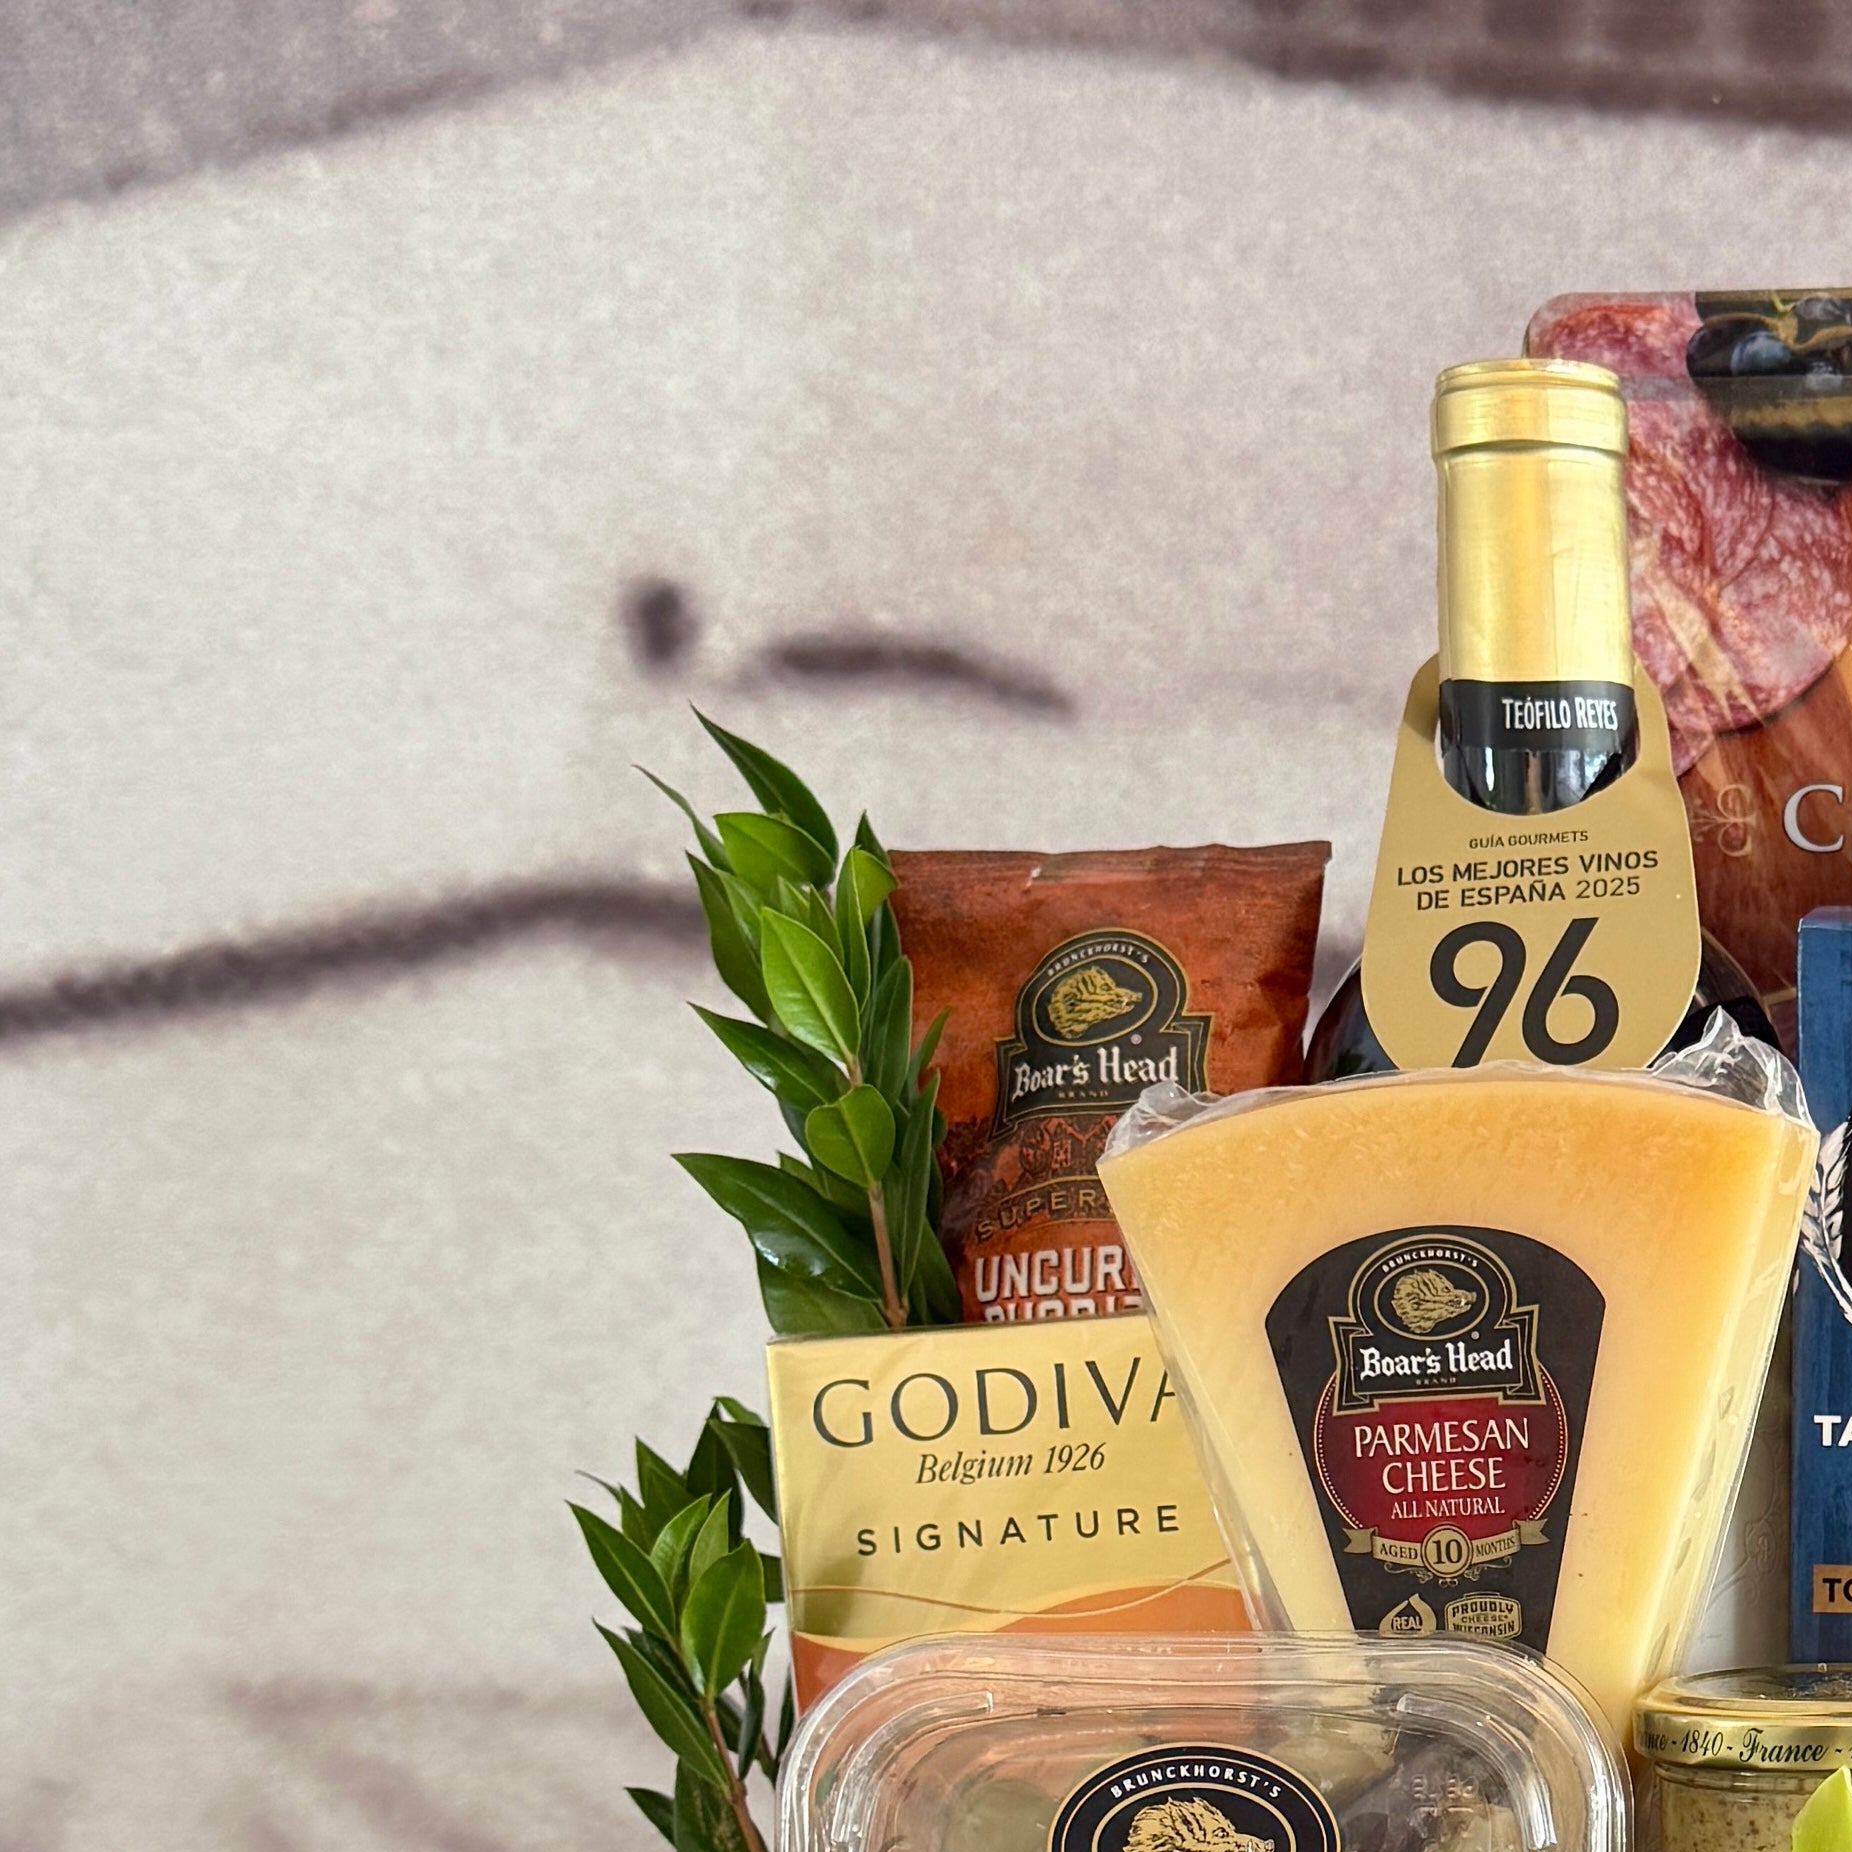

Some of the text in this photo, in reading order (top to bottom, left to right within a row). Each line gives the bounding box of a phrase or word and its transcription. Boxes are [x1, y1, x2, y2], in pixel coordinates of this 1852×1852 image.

[1502, 695, 1619, 731] TEÓFILO REYES
[1469, 830, 1589, 850] GUÍA GOURMETS
[1397, 850, 1659, 887] LOS MEJORES VINOS
[1417, 876, 1641, 912] DE ESPAÑA 2025
[1429, 916, 1620, 1069] 96
[1012, 1046, 1179, 1102] Boar's Head
[975, 1244, 1140, 1303] UNCUR
[1360, 1339, 1514, 1381] Boar's Head
[1353, 1417, 1530, 1459] PARMESAN
[915, 1441, 1107, 1487] Belgium 1926
[1382, 1456, 1506, 1495] CHEESE
[1391, 1496, 1506, 1520] ALL NATURAL
[856, 1504, 1180, 1557] SIGNATURE
[1380, 1536, 1516, 1565] AGED 10 MONTHS
[1393, 1615, 1423, 1631] REAL
[1452, 1600, 1514, 1618] PROUDLY
[1681, 1729, 1724, 1757] 1840
[1739, 1727, 1829, 1763] France
[1110, 1763, 1283, 1800] BRUNCKHORST'S
